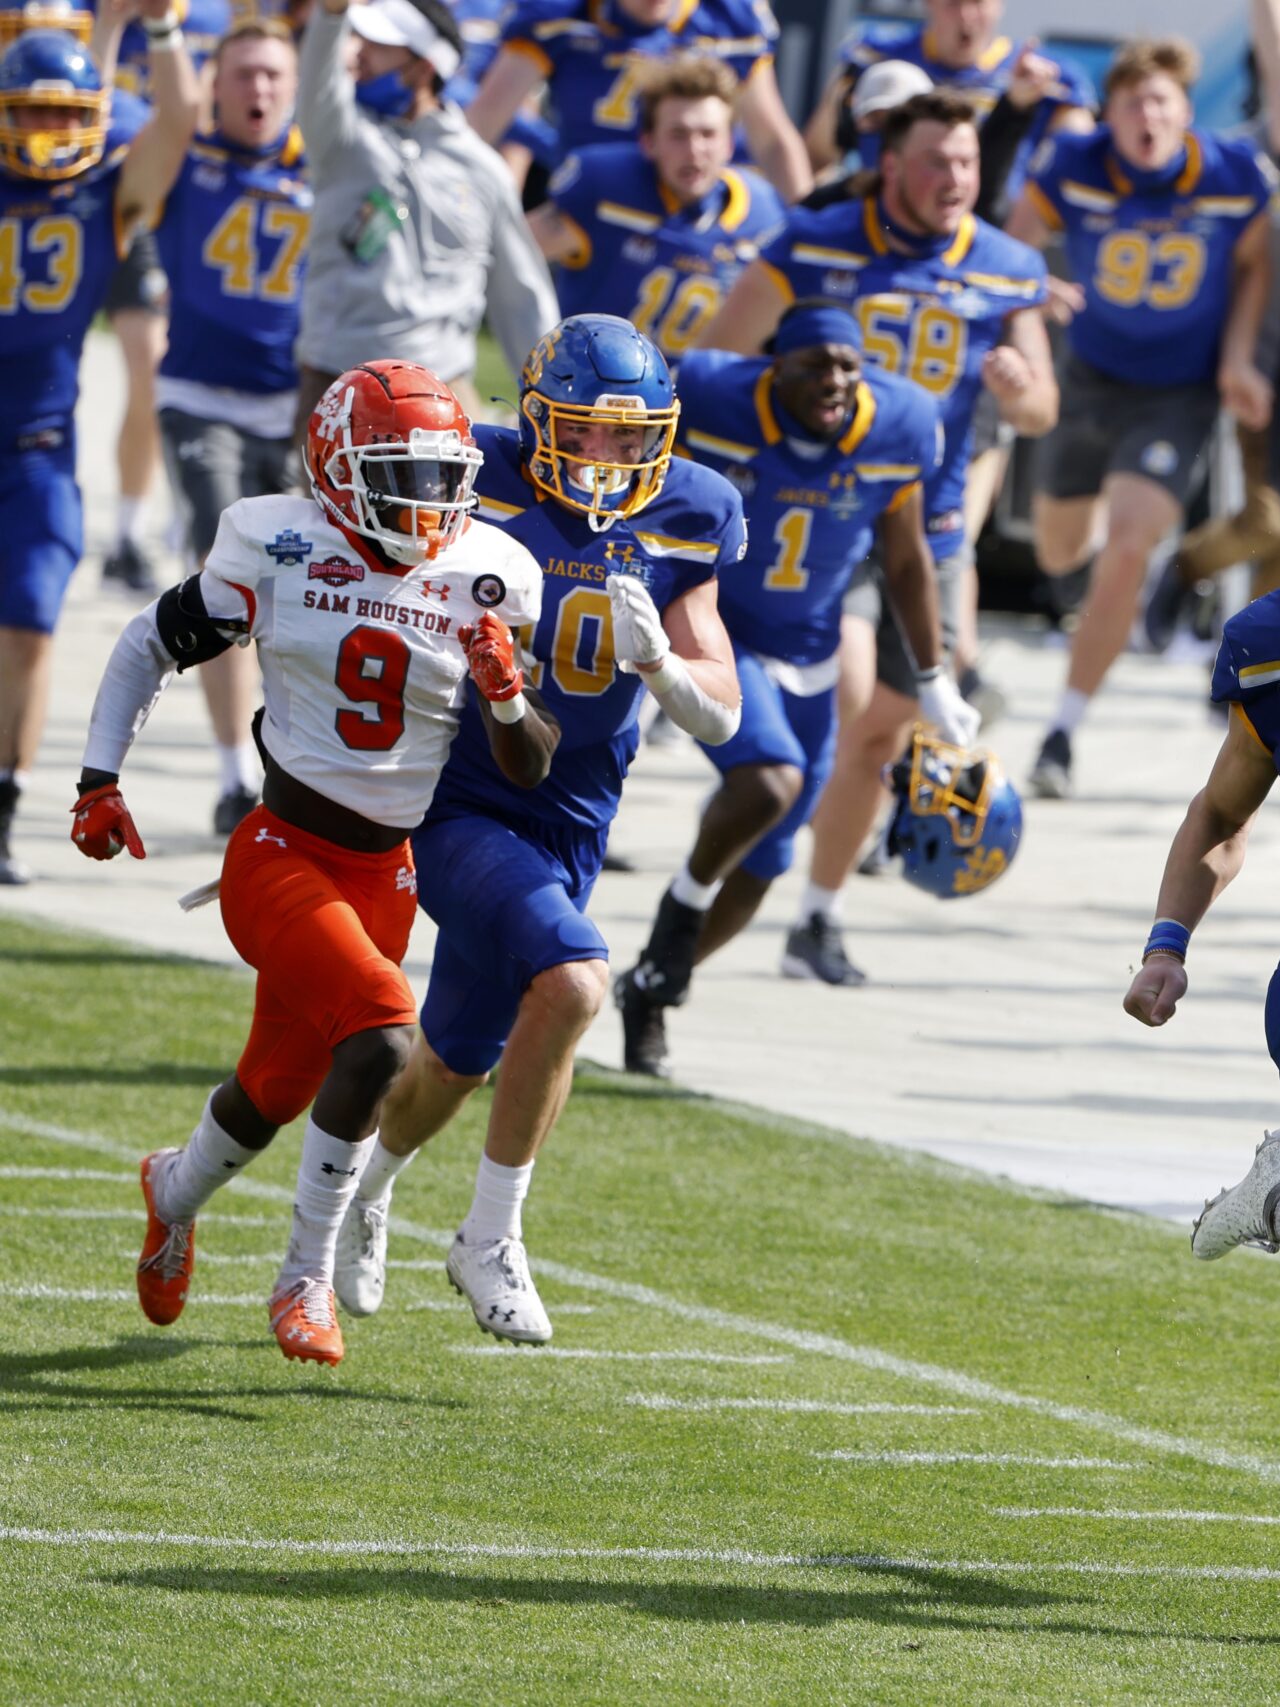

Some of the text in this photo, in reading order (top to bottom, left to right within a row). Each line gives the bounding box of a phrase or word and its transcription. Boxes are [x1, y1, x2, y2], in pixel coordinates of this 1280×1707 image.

[203, 196, 311, 303] 47
[1094, 230, 1206, 309] 93
[628, 266, 722, 356] 10
[853, 293, 968, 398] 58
[309, 563, 363, 579] SOUTHLAND
[542, 557, 606, 582] JACKS
[763, 506, 813, 591] 1
[304, 590, 452, 635] SAM HOUSTON
[519, 585, 617, 697] 0
[334, 623, 412, 750] 9
